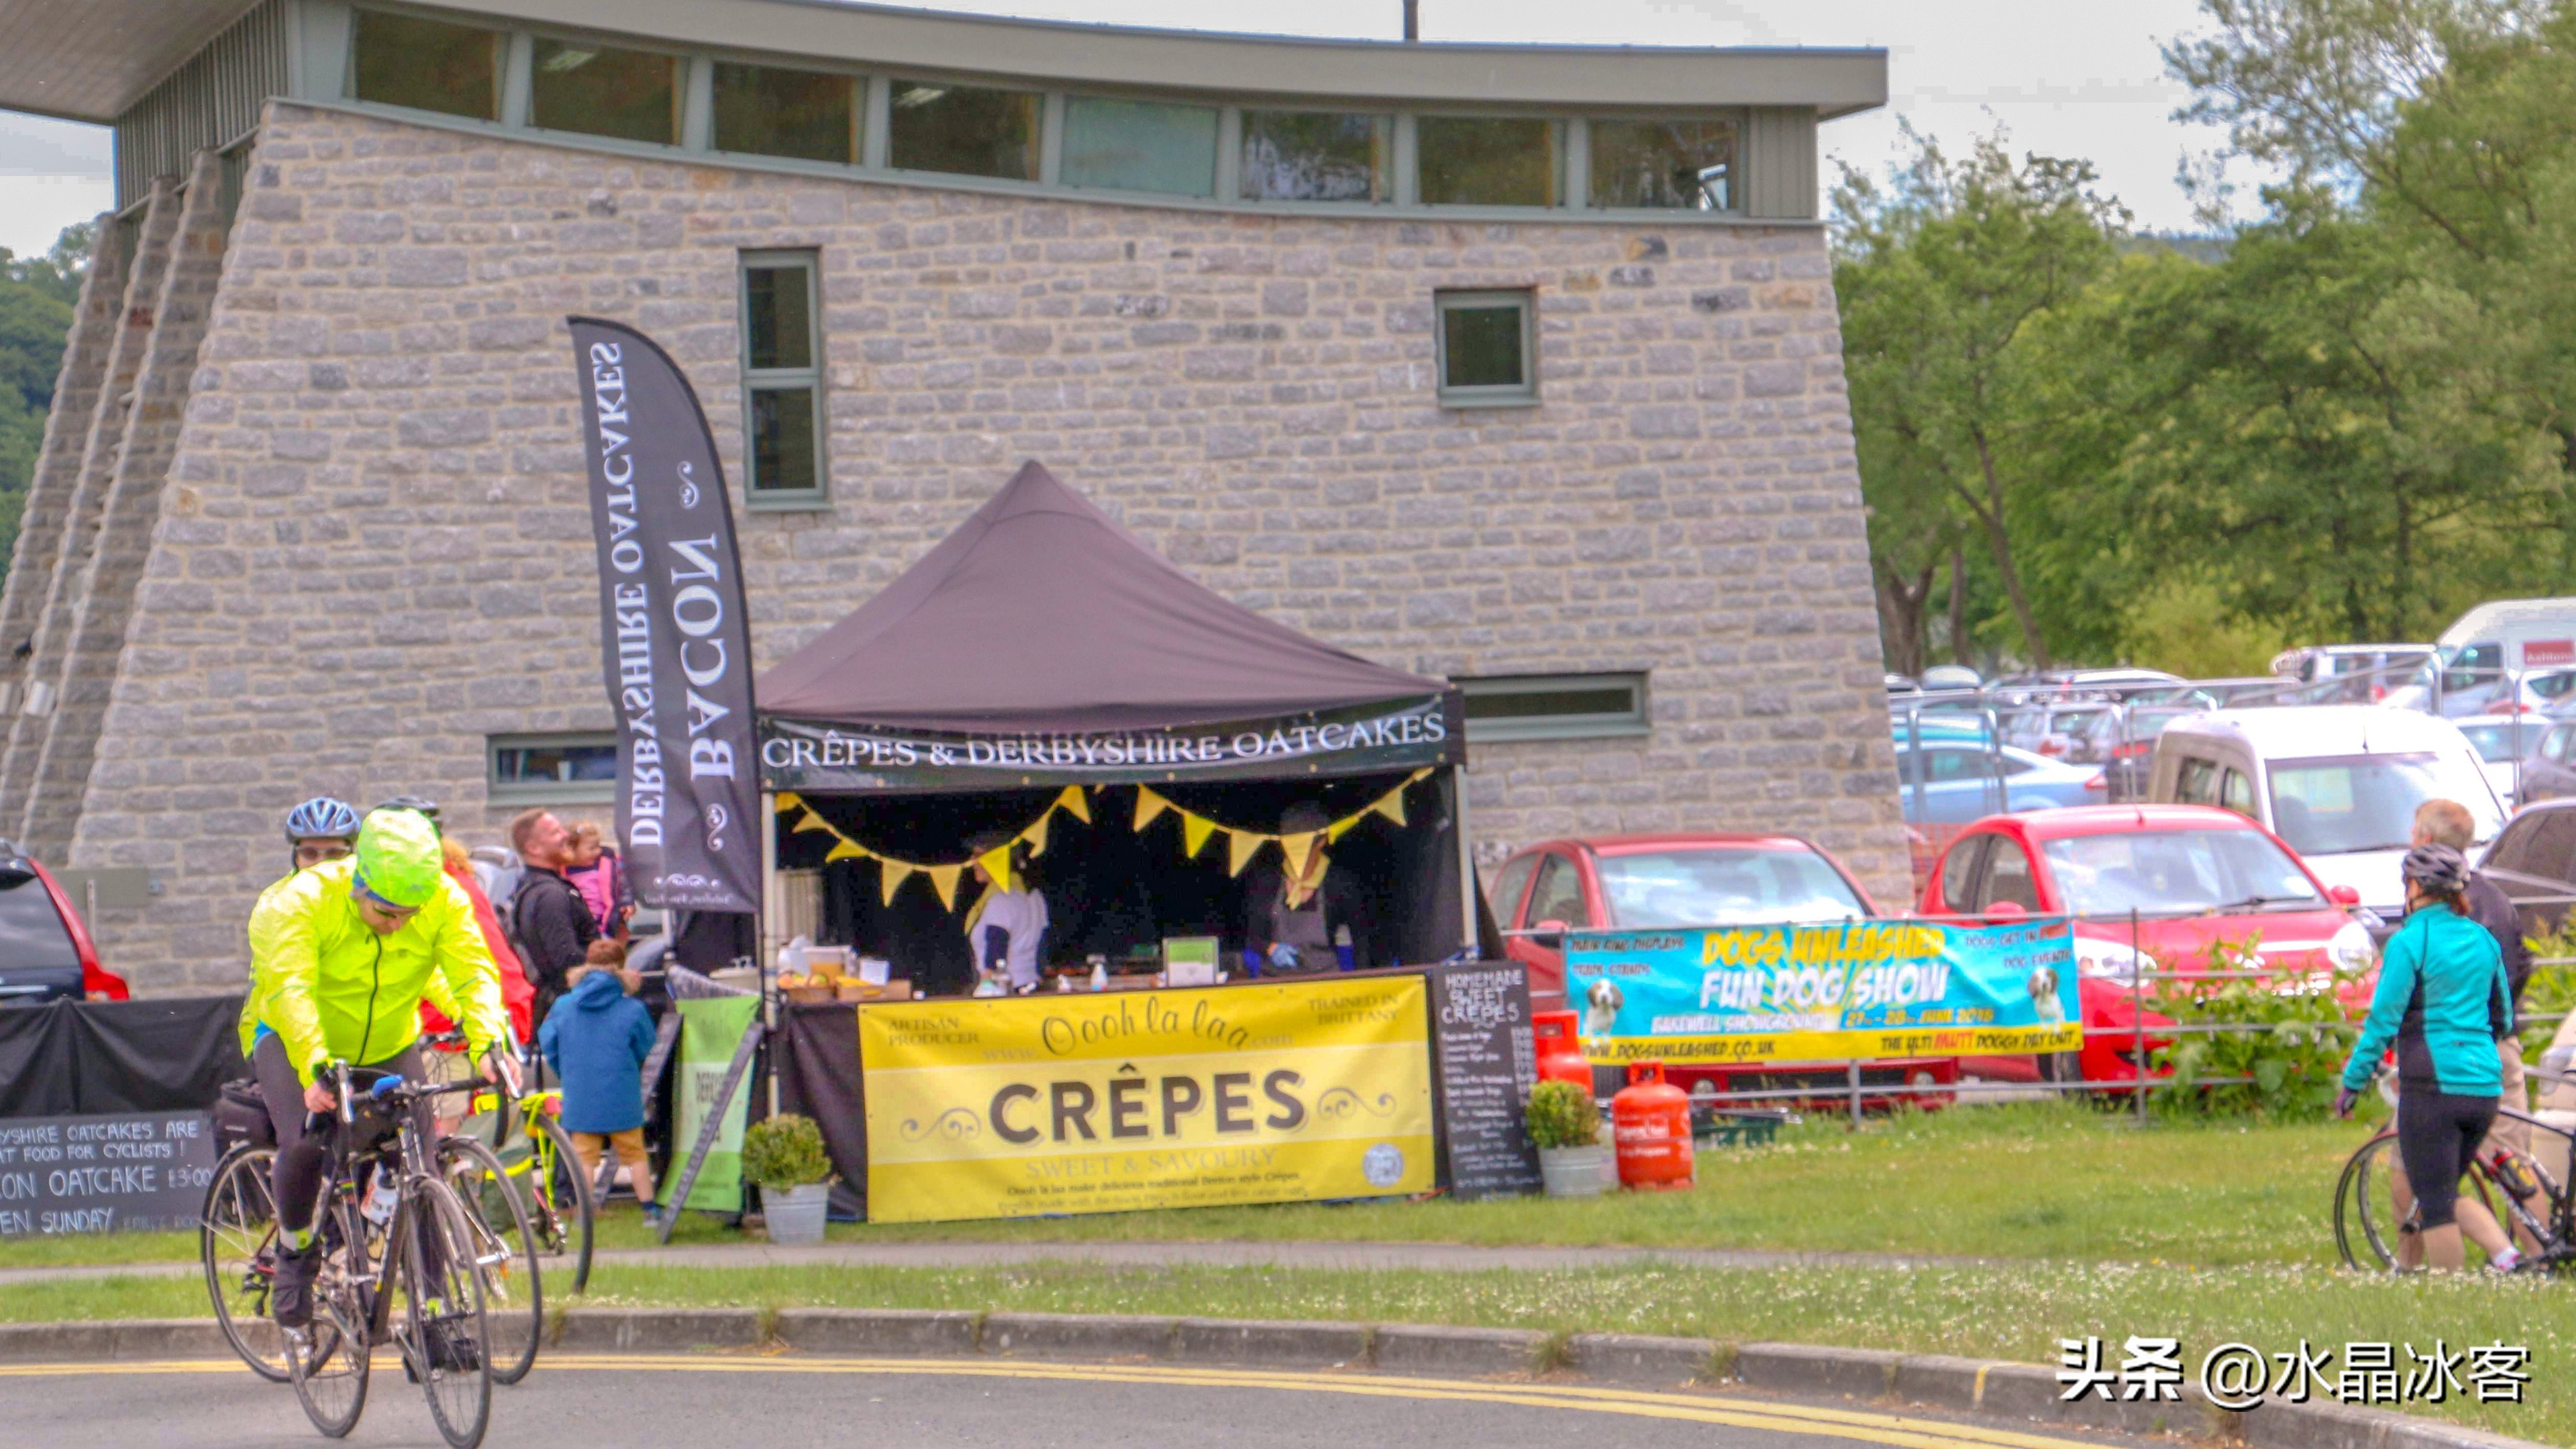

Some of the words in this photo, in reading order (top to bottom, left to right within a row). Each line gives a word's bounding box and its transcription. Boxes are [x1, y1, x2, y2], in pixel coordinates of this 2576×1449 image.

[762, 730, 917, 768] CRÊPES
[929, 742, 956, 766] &
[967, 734, 1221, 767] DERBYSHIRE
[1231, 713, 1446, 756] OATCAKES
[1702, 930, 1784, 966] DOGS
[1791, 926, 1946, 963] UNLEASHED
[1445, 969, 1523, 989] HOMEMADE
[1699, 970, 1766, 1010] FUN
[1772, 966, 1846, 1007] DOG
[1852, 962, 1951, 1006] SHOW
[1308, 994, 1378, 1010] TRAINED
[1381, 993, 1399, 1005] IN
[1449, 986, 1507, 1006] SWEET
[889, 1016, 959, 1031] ARTISAN
[1317, 1010, 1399, 1026] BRITTANY
[889, 1032, 979, 1046] PRODUCER
[1977, 1034, 2019, 1049] DOGGY
[2049, 1030, 2074, 1046] OUT
[988, 1062, 1309, 1145] CRÊPES
[67, 1121, 154, 1142] OATCAKES
[165, 1120, 200, 1139] ARE
[23, 1145, 62, 1162] FOOD
[67, 1143, 95, 1160] FOR
[103, 1142, 173, 1159] CYCLISTS
[1025, 1156, 1113, 1180] SWEET
[1124, 1157, 1138, 1174] &
[1147, 1147, 1278, 1171] SAVOURY
[48, 1165, 158, 1197] OATCAKE
[40, 1207, 115, 1234] SUNDAY
